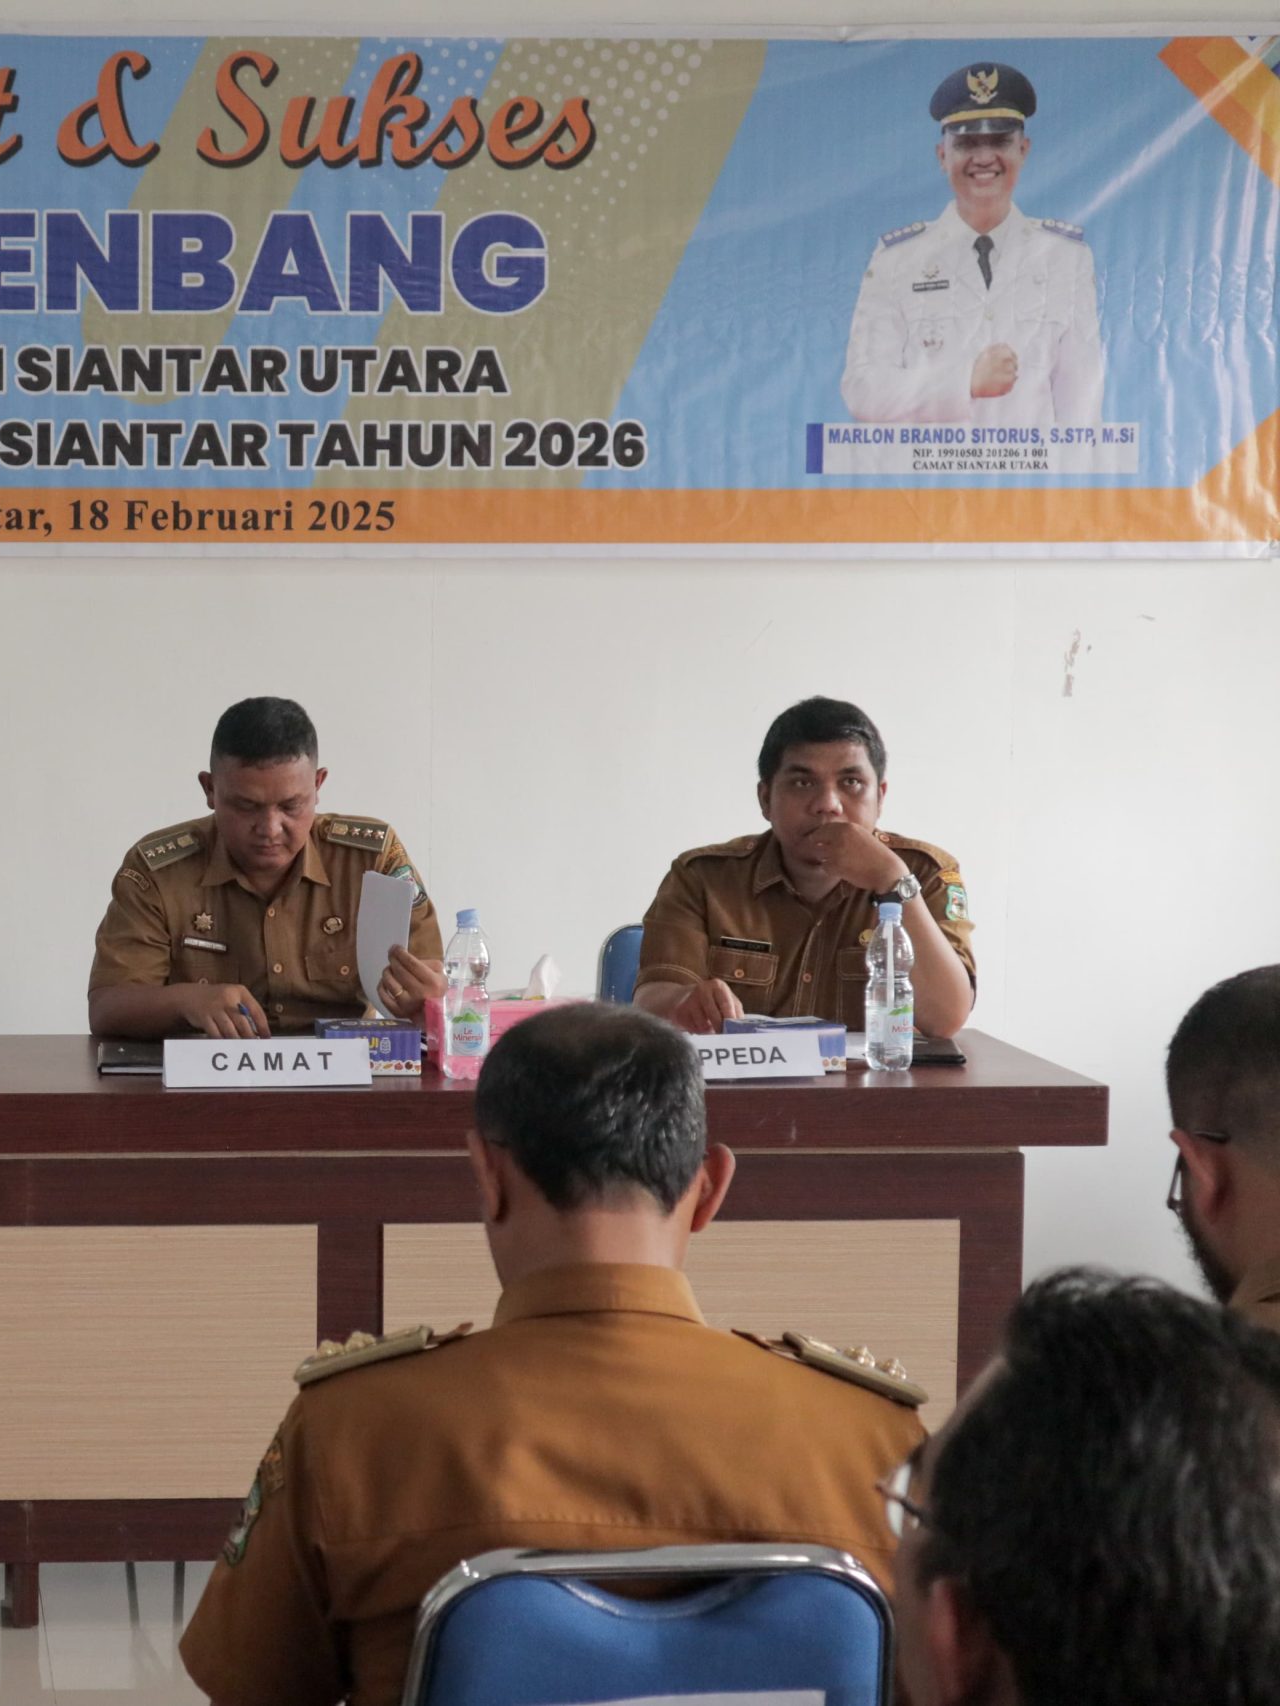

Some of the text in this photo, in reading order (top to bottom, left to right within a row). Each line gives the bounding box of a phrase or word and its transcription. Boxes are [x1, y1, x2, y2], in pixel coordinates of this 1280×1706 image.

[196, 50, 597, 169] Sukses
[16, 345, 288, 396] SIANTAR
[299, 346, 511, 396] UTARA
[277, 420, 495, 470] TAHUN
[502, 420, 649, 470] 2026
[828, 428, 1134, 447] MARLON BRANDO SITORUS, S.STP, M.Si
[913, 448, 934, 458] NIP.
[937, 448, 984, 458] 19910503
[986, 448, 1020, 458] 201206
[1031, 448, 1049, 458] 001
[913, 461, 1049, 471] CAMAT SIANTAR UTARA
[67, 498, 110, 531] 18
[123, 498, 295, 532] Februari
[308, 500, 396, 532] 2025
[211, 1051, 334, 1072] CAMAT
[698, 1046, 787, 1066] PPEDA
